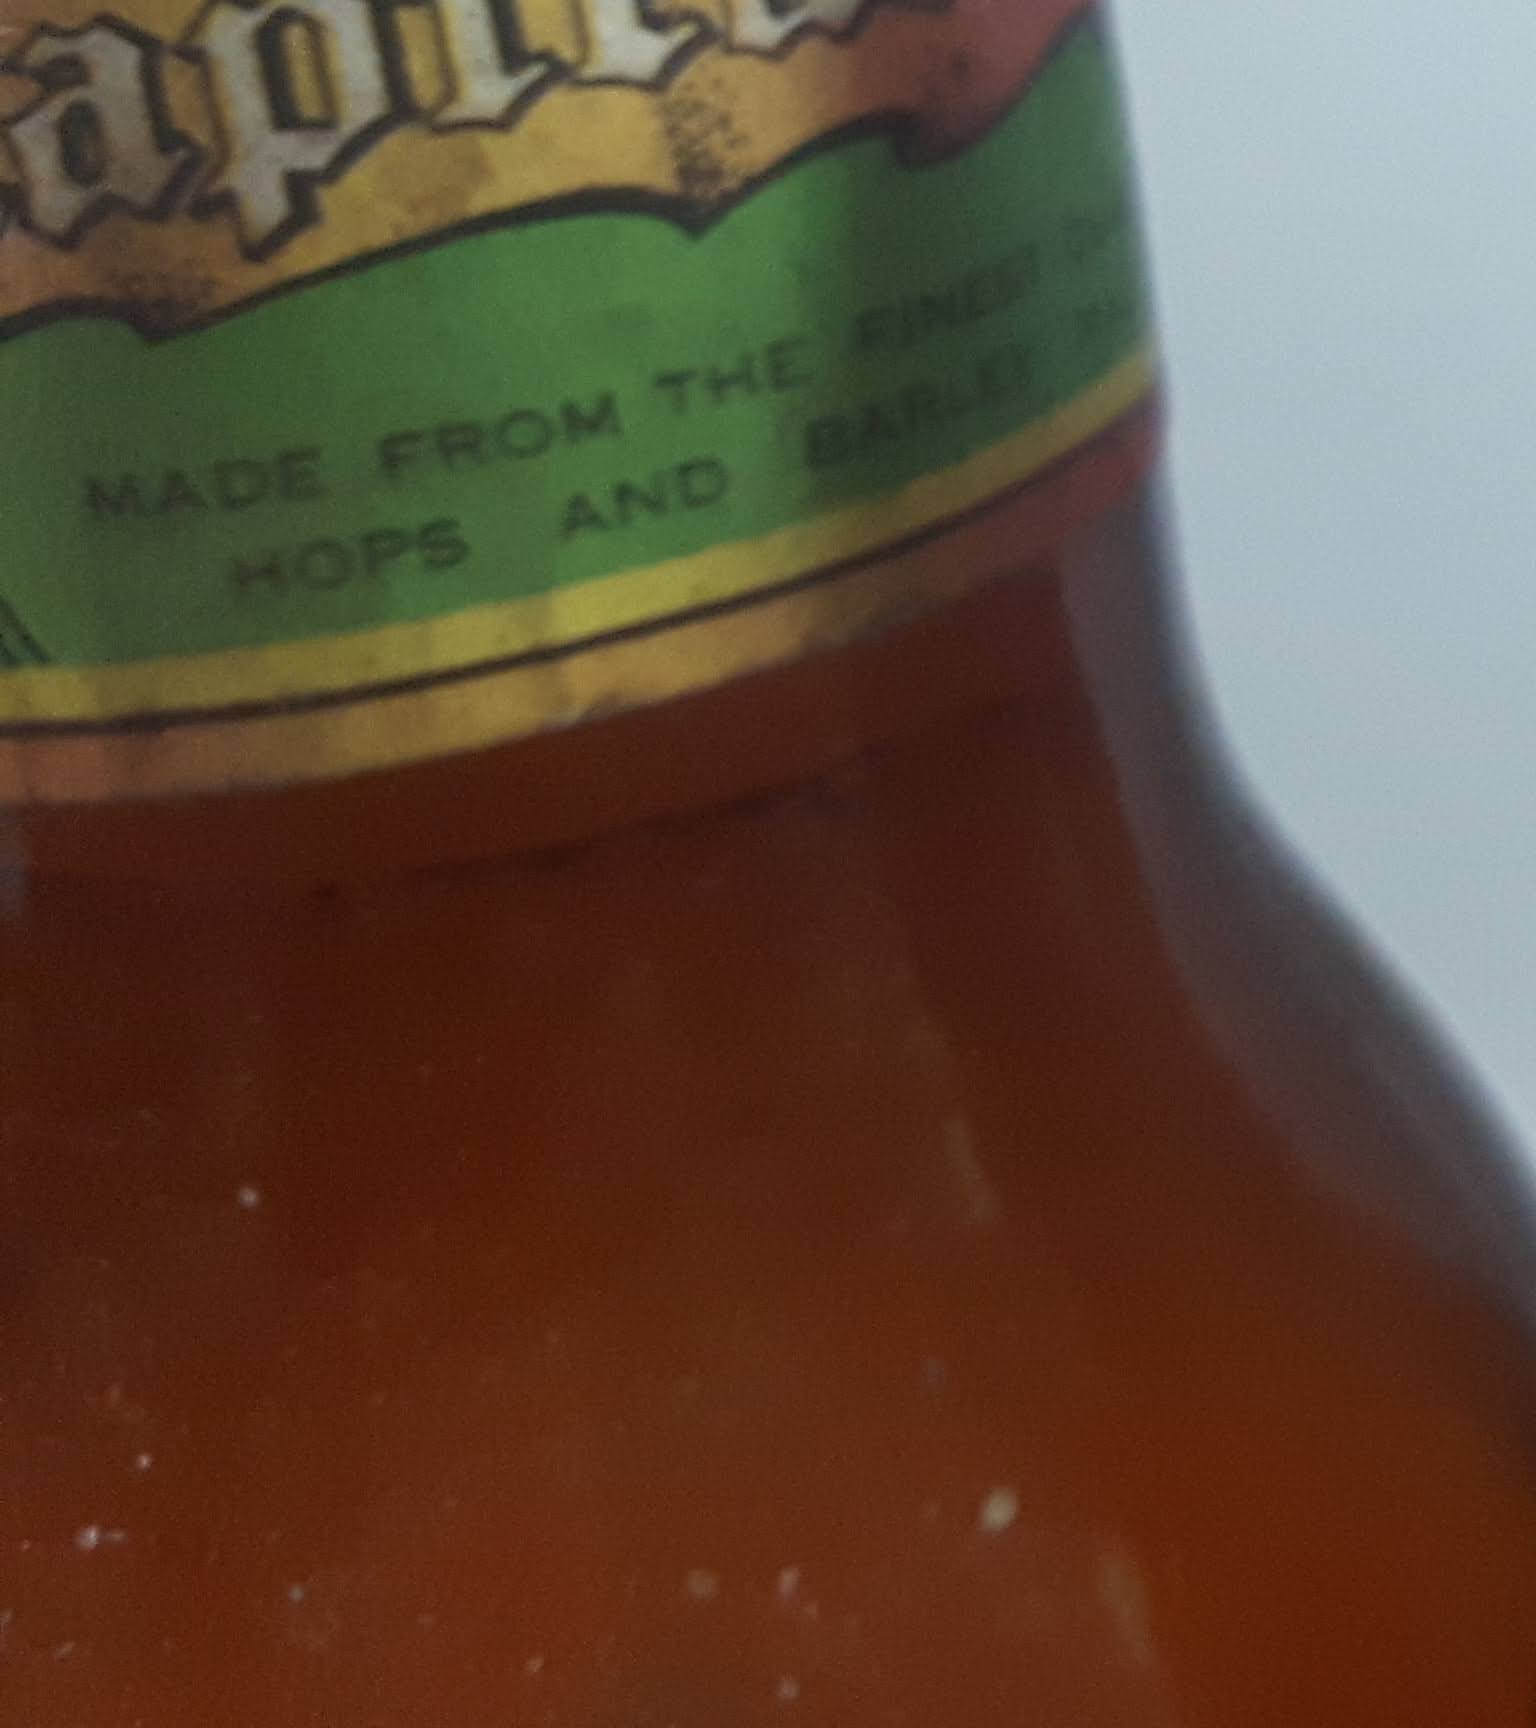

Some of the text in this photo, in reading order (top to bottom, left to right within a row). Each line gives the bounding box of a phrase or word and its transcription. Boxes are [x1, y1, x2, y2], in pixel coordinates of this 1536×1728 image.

[82, 445, 331, 520] MADE
[374, 388, 624, 478] FROM
[653, 334, 813, 414] THE
[228, 515, 473, 603] HOPS
[558, 454, 729, 541] AND
